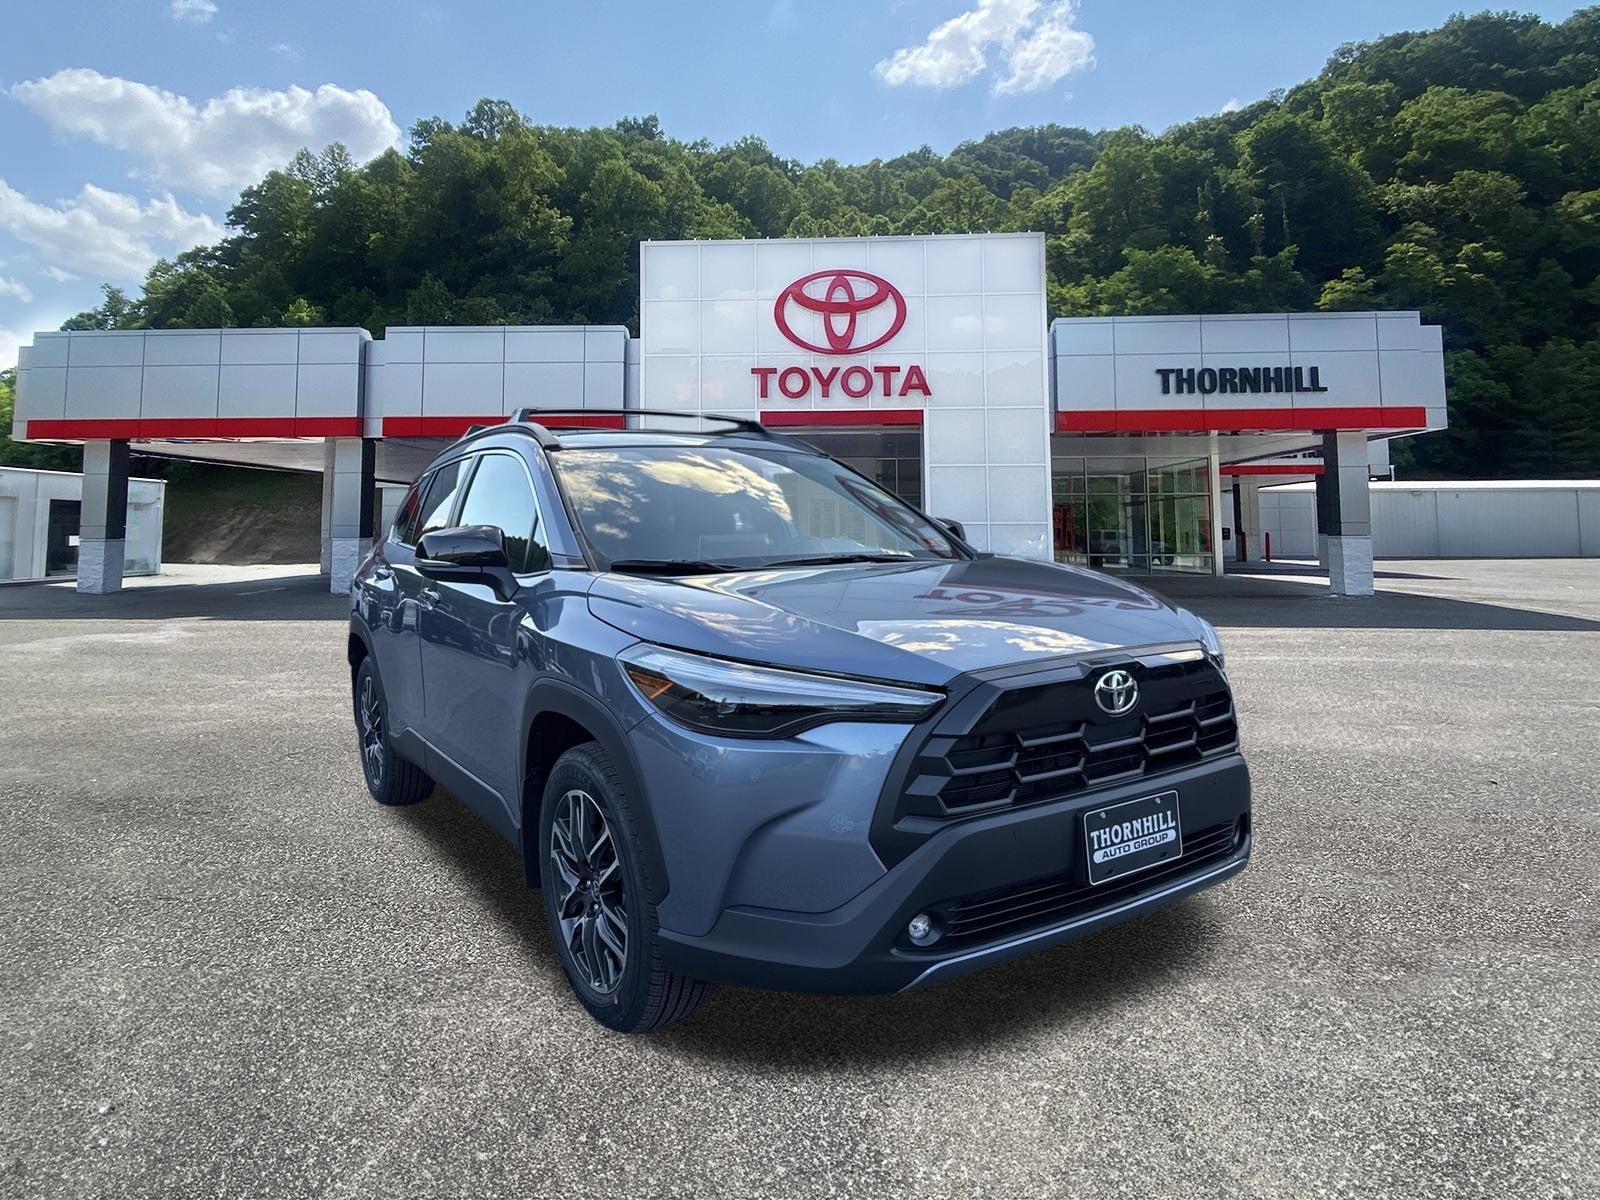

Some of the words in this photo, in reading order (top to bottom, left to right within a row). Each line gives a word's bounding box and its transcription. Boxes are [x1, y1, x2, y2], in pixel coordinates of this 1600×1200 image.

[750, 365, 932, 399] TOYOTA
[1155, 366, 1328, 394] THORNHILL
[1090, 810, 1176, 850] THORNHILL
[1102, 844, 1131, 860] AUTO
[1133, 833, 1169, 849] GROUP
